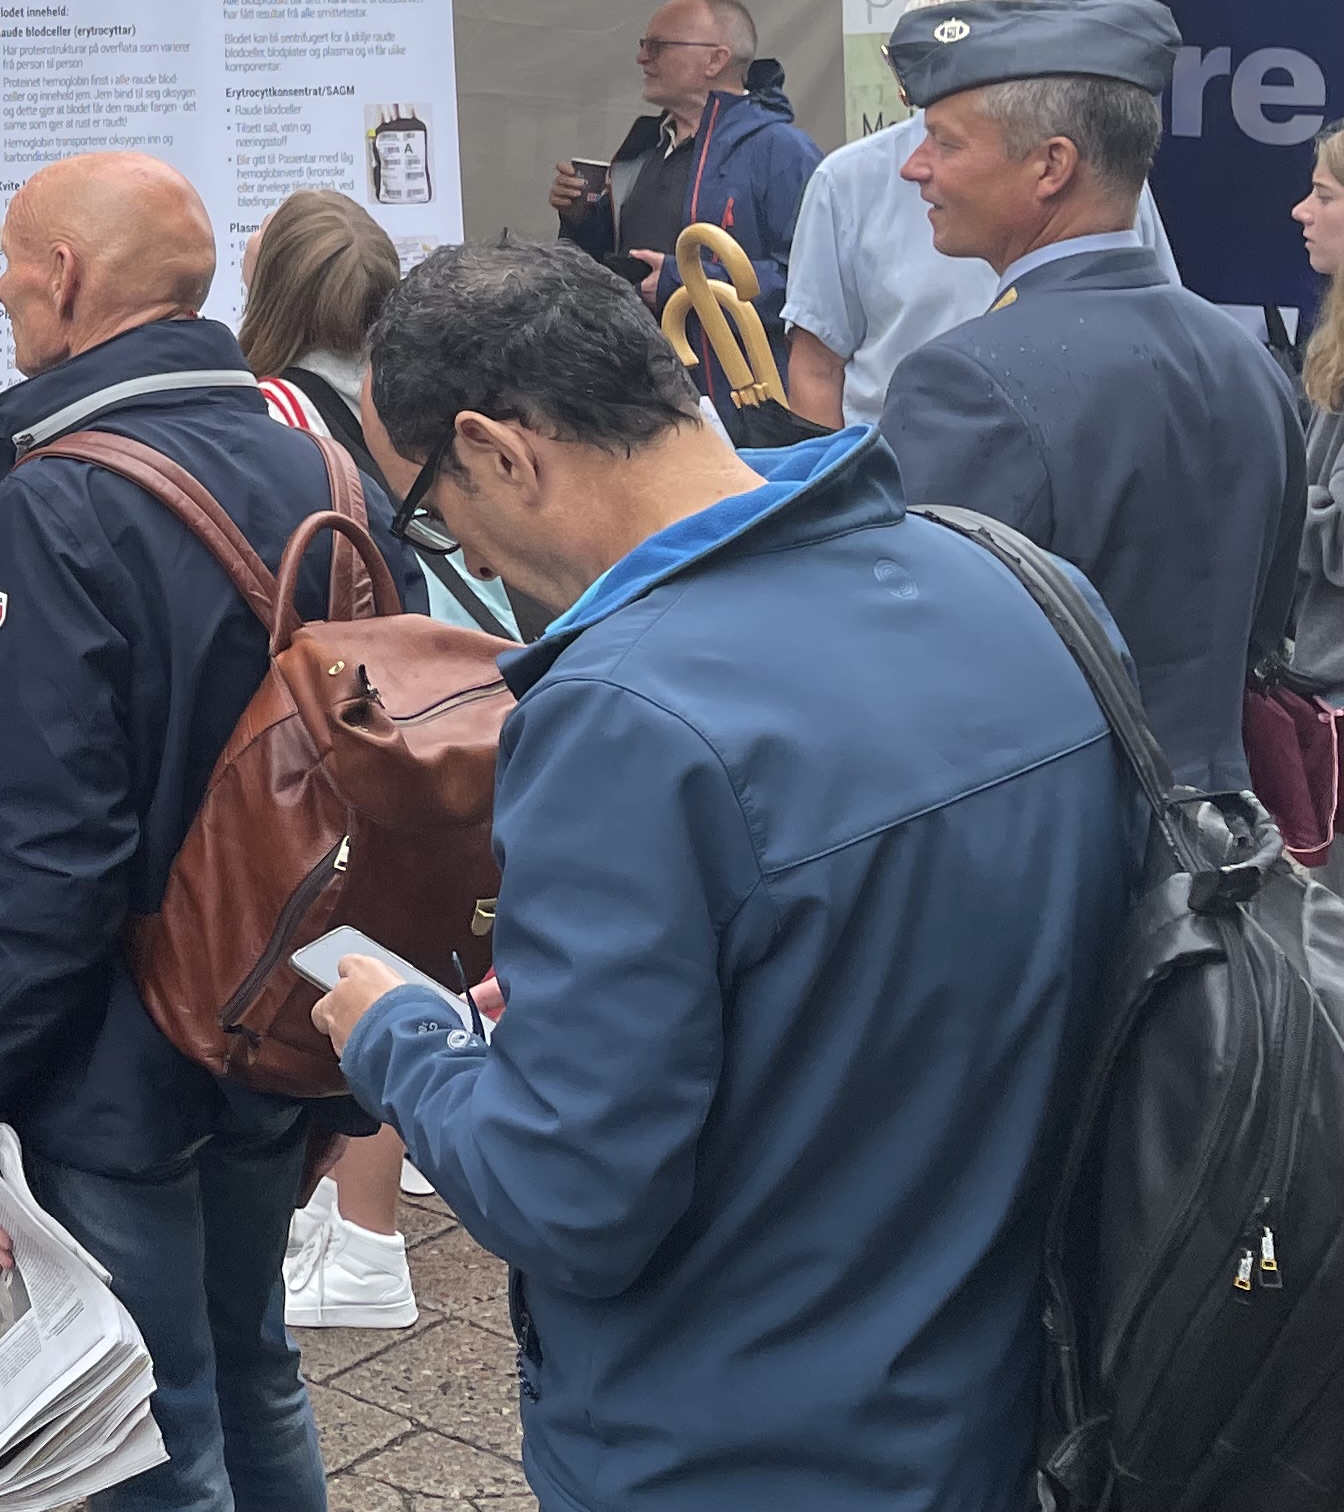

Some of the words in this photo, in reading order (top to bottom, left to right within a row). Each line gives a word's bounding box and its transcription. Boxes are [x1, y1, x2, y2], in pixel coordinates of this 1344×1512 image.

[26, 6, 70, 17] inneheld:
[26, 26, 71, 37] blodceller
[88, 43, 99, 56] på
[140, 44, 158, 53] som
[16, 60, 45, 71] person
[56, 59, 83, 70] person
[235, 105, 262, 115] Raude
[264, 104, 302, 114] blodceller
[236, 123, 261, 133] Tilsett
[300, 123, 311, 134] og
[109, 135, 145, 146] oksygen
[163, 135, 173, 146] og
[319, 153, 339, 163] med
[229, 223, 263, 233] Plasm
